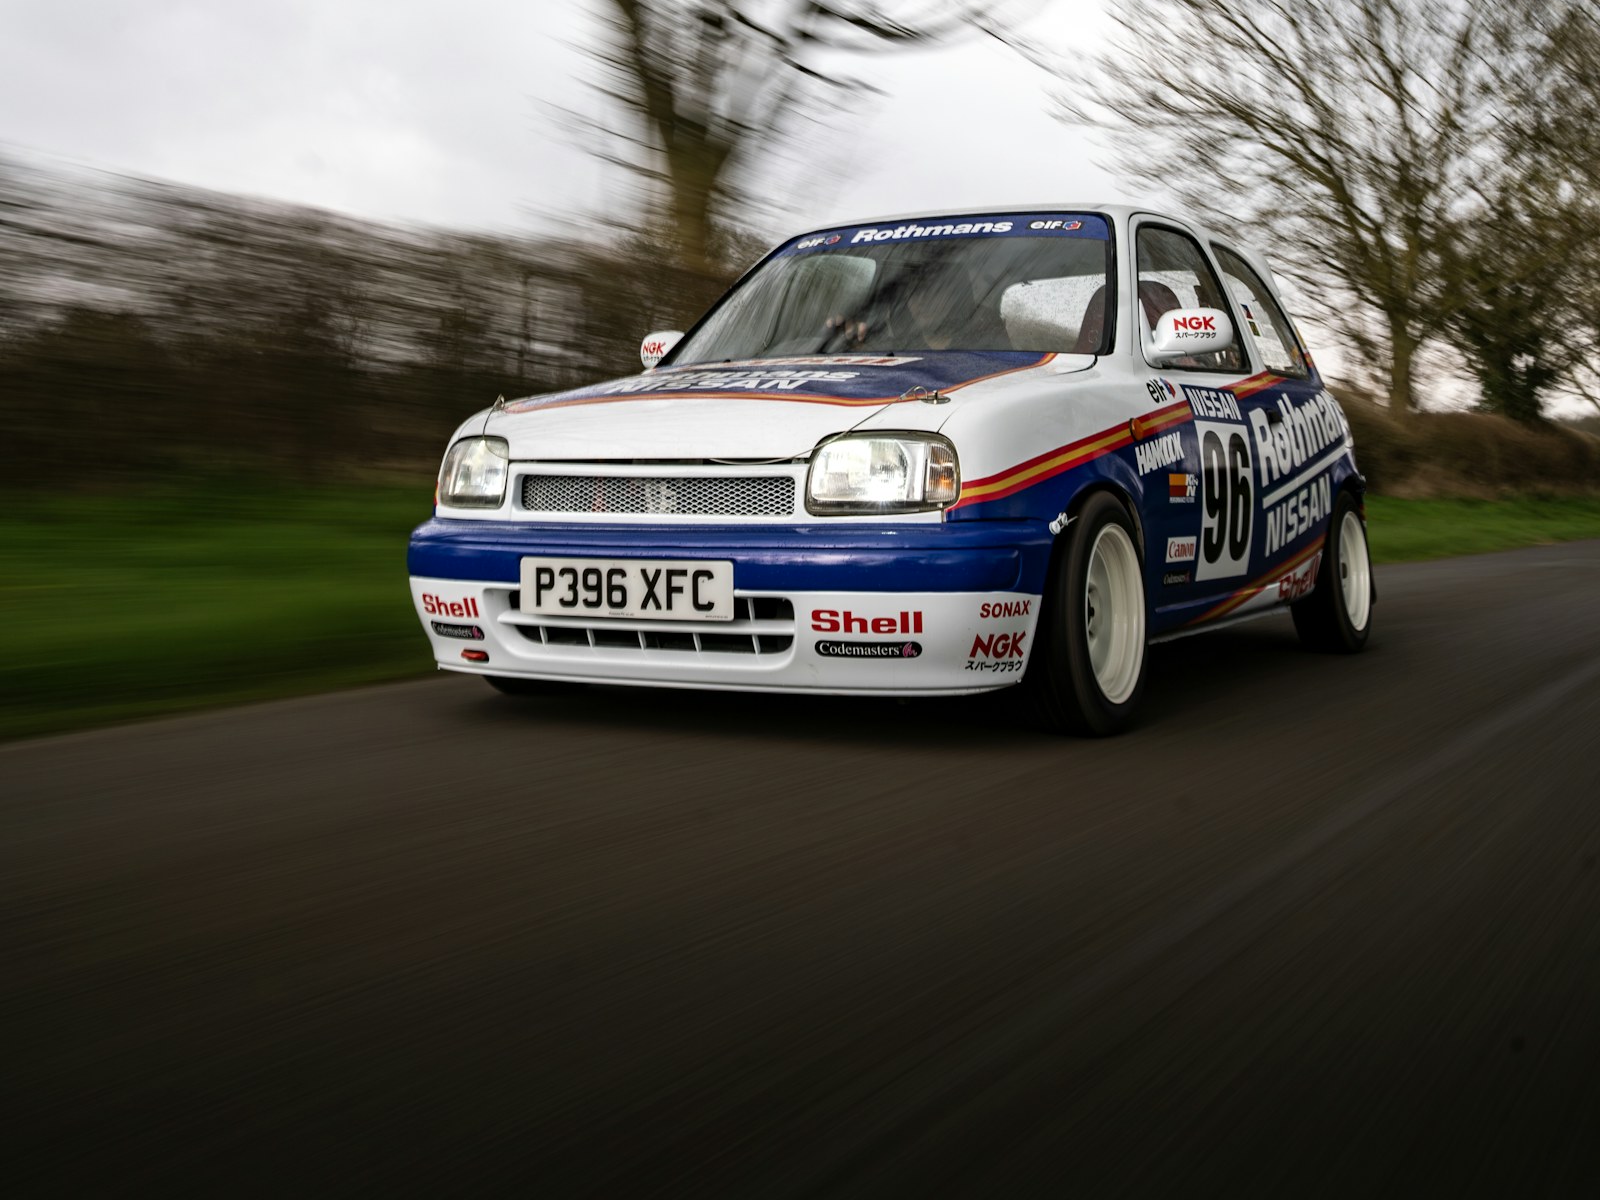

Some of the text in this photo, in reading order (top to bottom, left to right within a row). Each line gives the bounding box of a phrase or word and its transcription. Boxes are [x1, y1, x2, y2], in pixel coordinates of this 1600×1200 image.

[851, 221, 1014, 244] Rothmans
[1030, 220, 1062, 230] elf
[798, 236, 825, 250] elf
[1173, 316, 1216, 331] NGK
[642, 342, 666, 355] NGK
[604, 378, 809, 395] NISSAN
[1146, 380, 1168, 404] elf
[1184, 388, 1242, 420] NISSAN
[1135, 431, 1185, 477] HANKOOK
[1203, 430, 1251, 565] 96
[1265, 473, 1332, 558] NISSAN
[1168, 541, 1195, 559] Canon
[535, 567, 715, 612] P396 XFC
[422, 593, 479, 618] Shell
[980, 600, 1031, 618] SONAX
[811, 609, 923, 634] Shell
[819, 641, 901, 656] Codemasters
[969, 630, 1026, 659] NGK
[965, 660, 1024, 672] スパークプラグ
